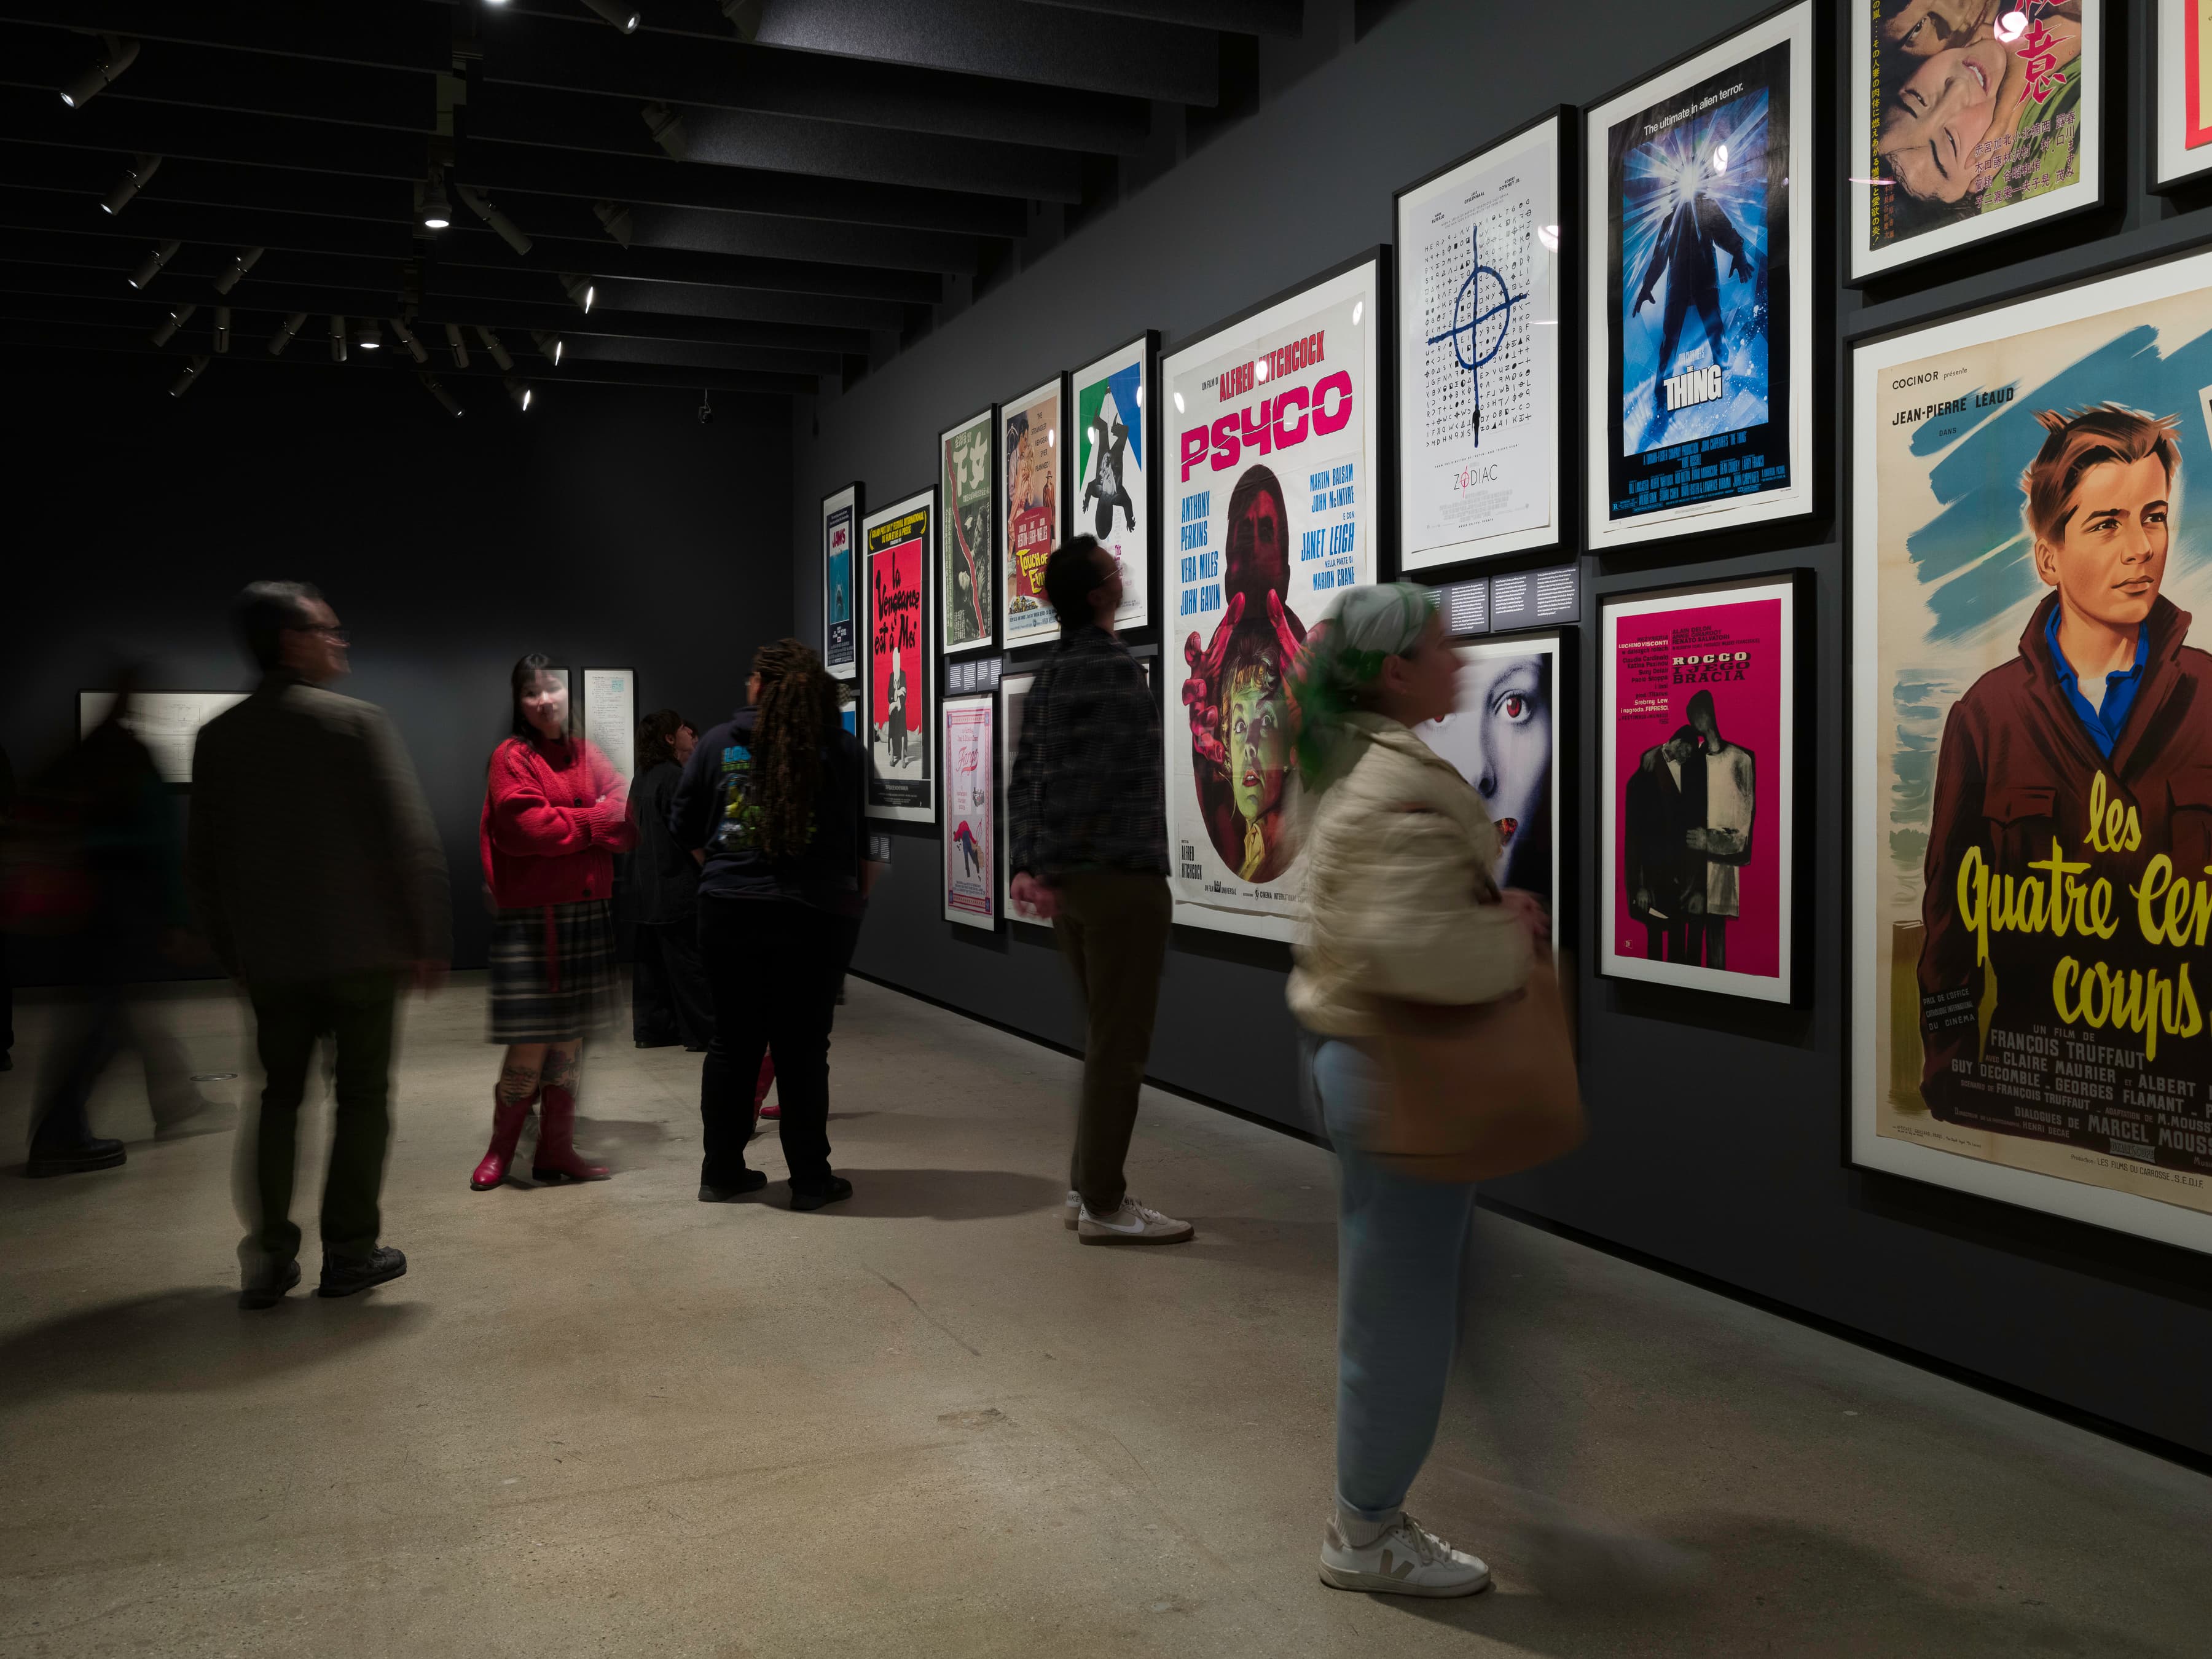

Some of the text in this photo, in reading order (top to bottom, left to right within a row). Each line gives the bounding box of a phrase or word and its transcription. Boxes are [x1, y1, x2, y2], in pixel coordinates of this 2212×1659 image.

[1644, 82, 1744, 136] The ultimate in alien terror.
[1202, 381, 1207, 391] UN
[1215, 376, 1219, 386] DI
[1220, 361, 1254, 402] ALFRED
[1258, 330, 1325, 386] HITCHCOCK
[1892, 367, 1967, 390] COCINOR présente
[1663, 364, 1722, 411] THING
[1892, 387, 2014, 426] JEAN-PIERRE LÉAUD
[1181, 370, 1353, 483] PSYCO
[1939, 428, 1957, 436] DANS
[1310, 463, 1354, 492] MARTIN BALSAM
[1453, 464, 1498, 491] ZODIAC
[1181, 490, 1210, 523] ANTHONY
[1312, 485, 1355, 513] JOHN McINTIRE
[1343, 510, 1355, 520] E CON
[832, 528, 846, 548] JAWS
[1181, 520, 1207, 552] PERKINS
[1301, 522, 1355, 562] JANET LEIGH
[1181, 551, 1218, 584] VERA MILES
[1325, 555, 1354, 568] NELLA PARTE DI
[1313, 567, 1355, 591] MARION CRANE
[876, 570, 920, 626] Vengeance
[1180, 583, 1220, 616] JOHN GAVIN
[1673, 652, 1751, 665] ROCCO
[1687, 662, 1750, 673] JEGO
[1673, 670, 1746, 684] BRACIA
[2084, 769, 2142, 852] les
[1182, 845, 1194, 861] ALFRED
[1182, 863, 1202, 880] HITCHCOCK
[1221, 887, 1237, 895] UNIVERSAL
[2129, 853, 2212, 947] Cen
[1923, 988, 1970, 1006] PRIX DE L'OFFICE
[2052, 955, 2203, 1062] coups
[2033, 1024, 2095, 1042] UN FILM DE
[1991, 1029, 2144, 1070] FRANÇOIS TRUFFAUT
[1951, 1058, 2184, 1113] GUY DECOMBLE GEORGES FLAMANT
[1985, 1054, 1999, 1063] AVEC
[2003, 1051, 2048, 1072] CLAIRE
[2055, 1060, 2116, 1084] MAURIER
[2138, 1073, 2196, 1097] ALBERT
[1996, 1083, 2041, 1101] FRANÇOIS
[2044, 1092, 2091, 1110] TRUFFAUT
[2104, 1107, 2140, 1120] ADAPTATION
[2157, 1113, 2212, 1134] M.MOUSS
[2015, 1105, 2061, 1126] DIALOGUES
[2068, 1116, 2080, 1129] DE
[2088, 1114, 2150, 1142] MARCEL
[2022, 1121, 2070, 1138] HENRI DECAE
[2097, 1158, 2109, 1167] LES
[2111, 1161, 2128, 1172] FILMS
[2130, 1164, 2138, 1174] DU
[2139, 1167, 2170, 1180] CARROSSE
[2175, 1175, 2204, 1189] S.E.D.I.F.
